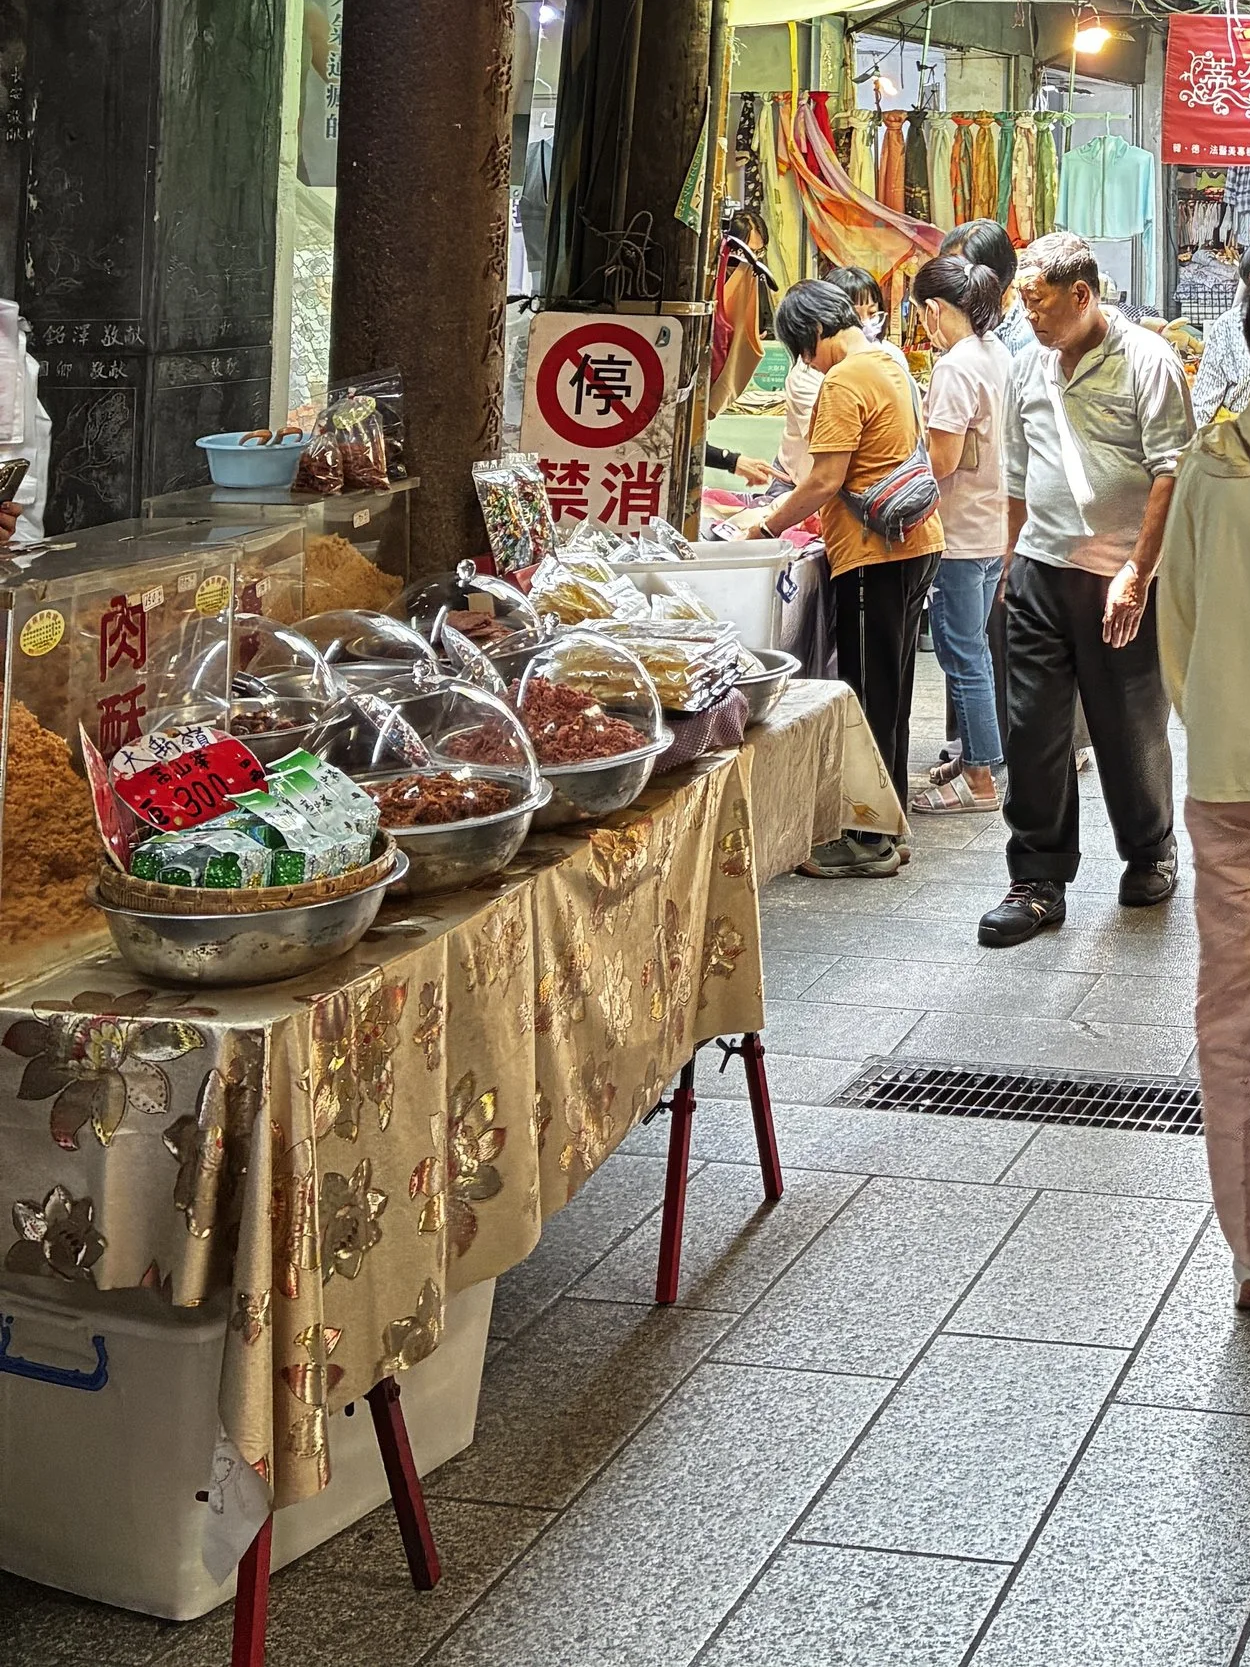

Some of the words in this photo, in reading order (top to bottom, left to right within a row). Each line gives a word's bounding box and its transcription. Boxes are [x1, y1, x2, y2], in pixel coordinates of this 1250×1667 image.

[569, 353, 632, 416] 停
[537, 458, 664, 526] 禁消
[173, 772, 230, 818] 300
